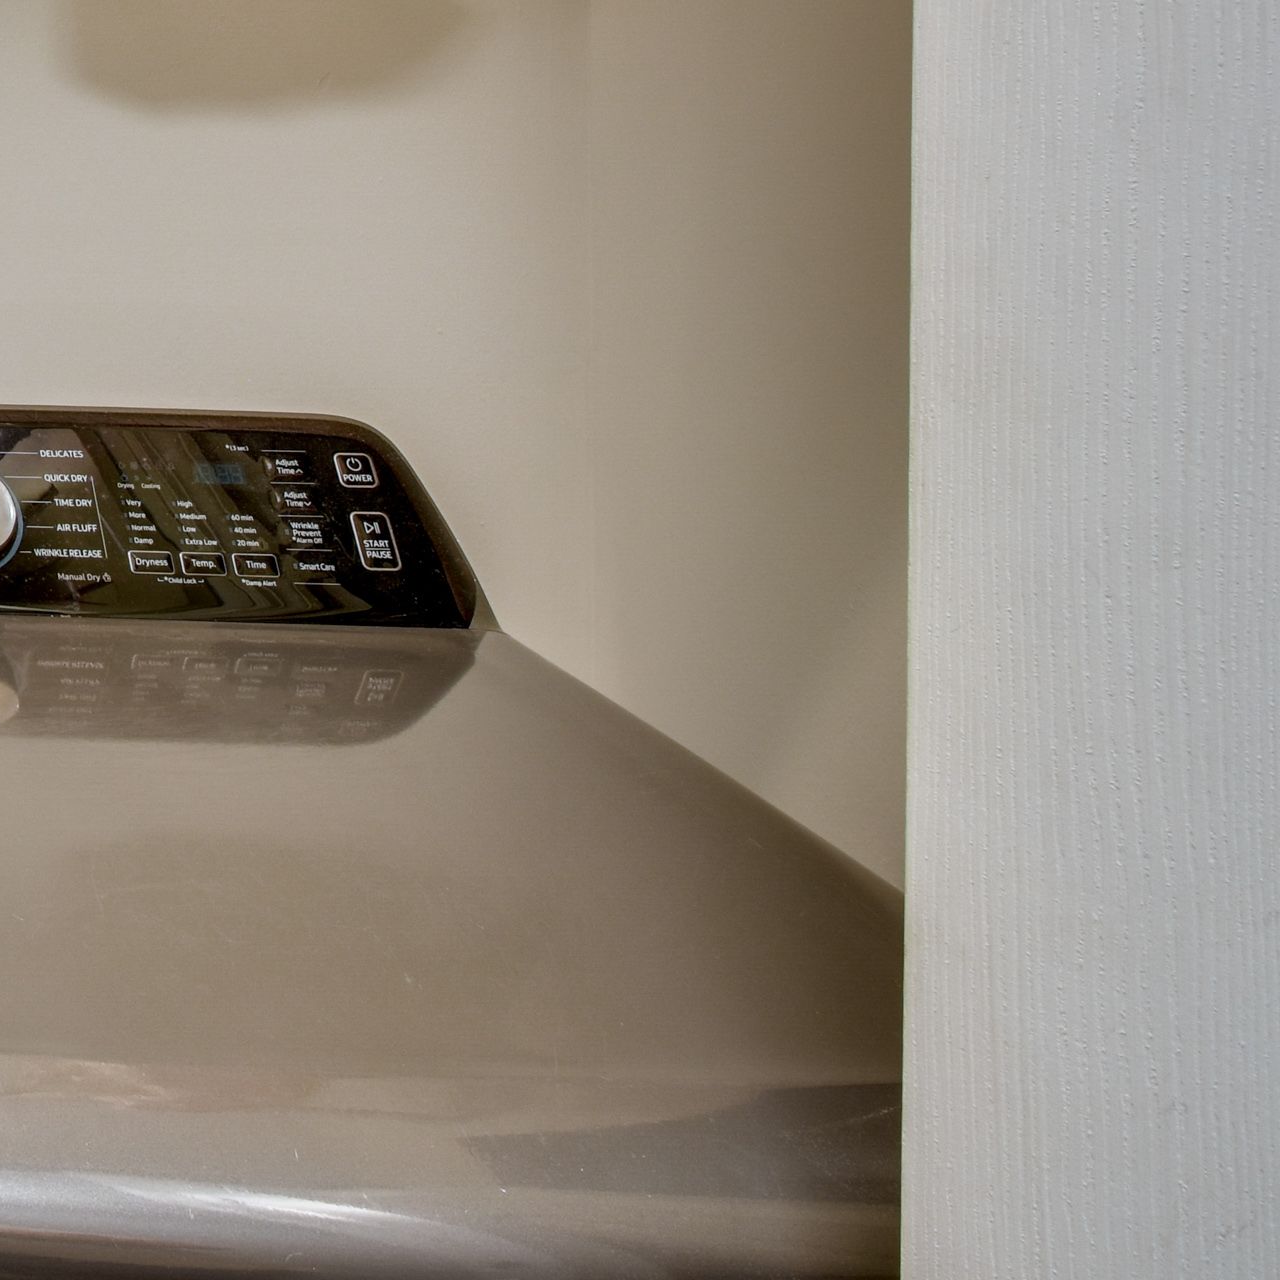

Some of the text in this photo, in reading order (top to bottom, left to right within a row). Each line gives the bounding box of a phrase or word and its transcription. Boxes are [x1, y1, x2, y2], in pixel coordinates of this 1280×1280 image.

[40, 450, 84, 458] DELICATES
[275, 459, 299, 468] Adjust
[44, 474, 87, 482] QUICK DRY
[343, 474, 373, 482] POWER
[284, 491, 308, 500] Adjust
[53, 499, 92, 507] TIME DRY
[177, 500, 193, 508] High
[56, 524, 97, 532] AIR FLUFF
[290, 522, 319, 530] Wrinkle
[292, 529, 322, 537] Prevent
[185, 538, 203, 546] Extra
[363, 540, 389, 548] START
[34, 548, 103, 559] WRINKLE RELEASE
[365, 550, 393, 559] PAUSE
[136, 558, 169, 567] Dryness
[191, 559, 217, 568] Temp.
[245, 560, 267, 569] Time
[57, 573, 101, 582] Manual Dry
